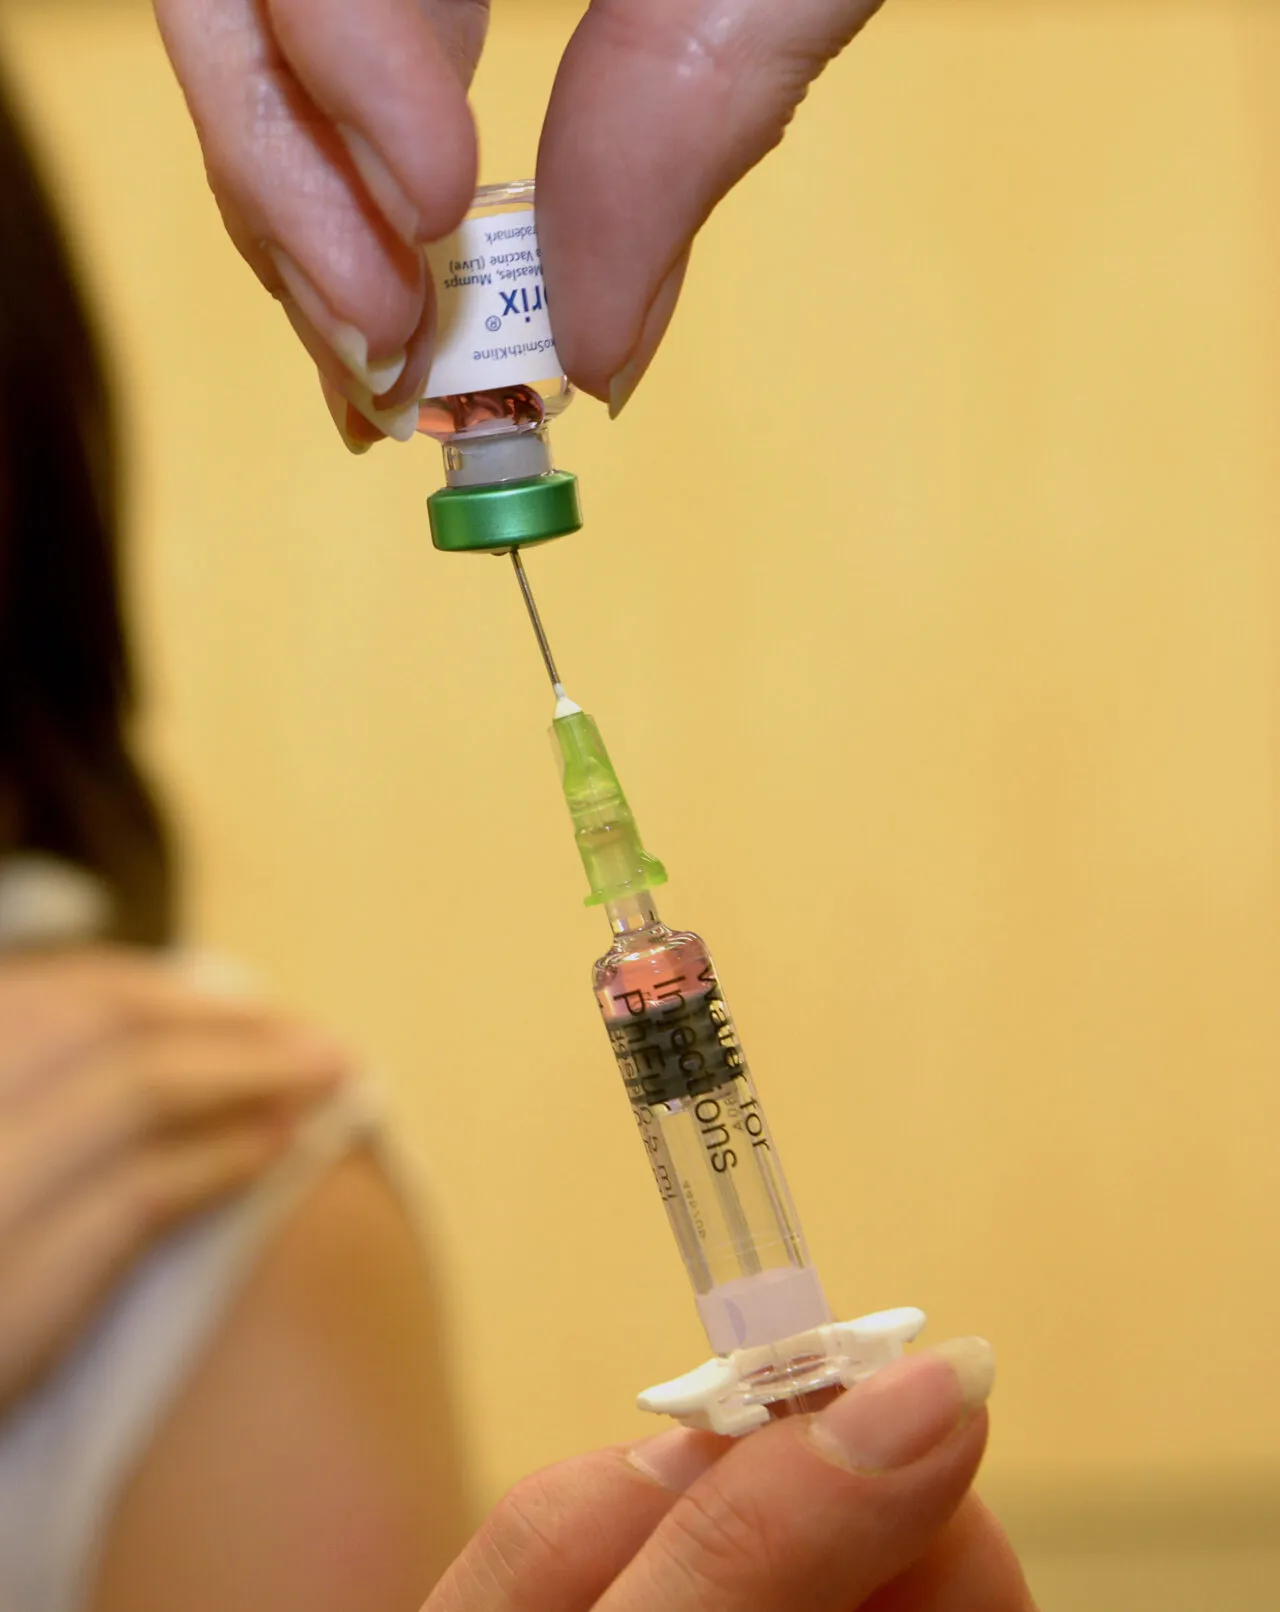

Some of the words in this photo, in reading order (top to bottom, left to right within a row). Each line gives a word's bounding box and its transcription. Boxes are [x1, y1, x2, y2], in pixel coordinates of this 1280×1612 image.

[485, 225, 536, 246] rademark
[449, 255, 486, 274] (Live)
[490, 251, 534, 267] Vaccine
[444, 272, 492, 290] Mumps
[473, 338, 555, 361] xoSmithKline
[653, 976, 738, 1174] Injections
[739, 1098, 770, 1151] for
